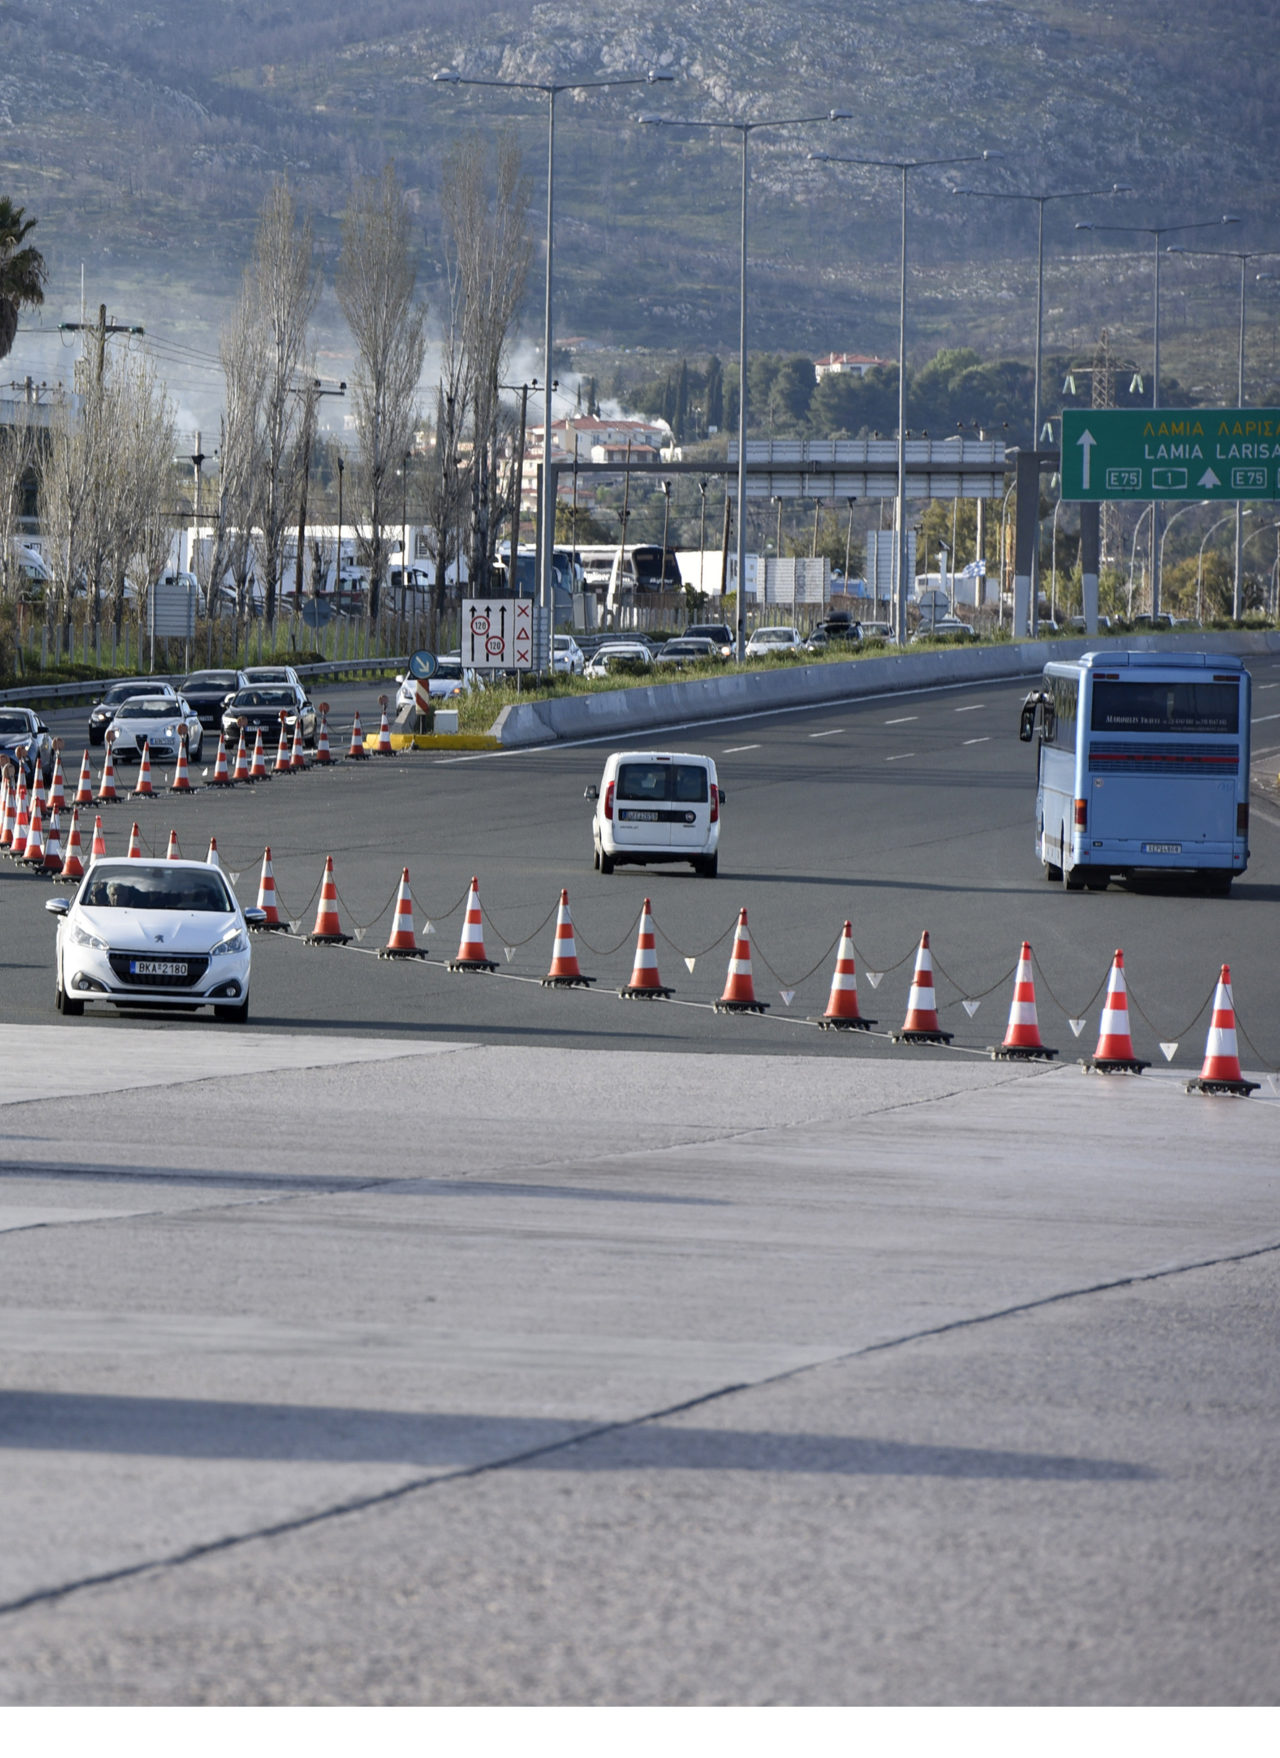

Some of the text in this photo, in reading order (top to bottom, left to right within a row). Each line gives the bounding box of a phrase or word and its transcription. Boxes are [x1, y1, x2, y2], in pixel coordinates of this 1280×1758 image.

[1143, 421, 1204, 437] ΛΑΜΙΑ
[1144, 444, 1203, 459] LAMIA
[489, 642, 501, 650] 120
